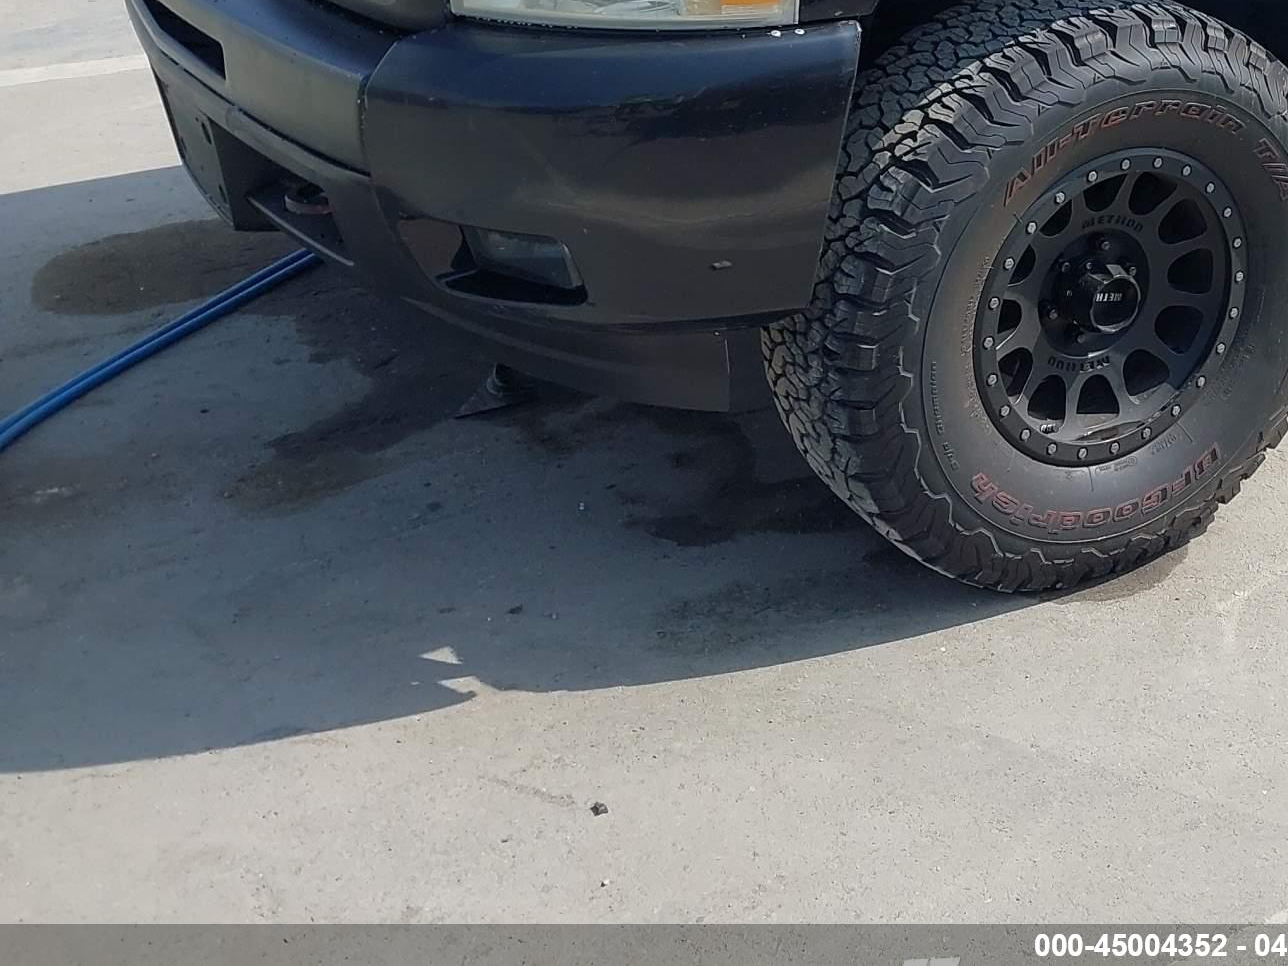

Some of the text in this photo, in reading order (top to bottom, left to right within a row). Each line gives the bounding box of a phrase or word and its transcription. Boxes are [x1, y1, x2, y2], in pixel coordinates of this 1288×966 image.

[1002, 97, 1249, 207] All-Terrain
[1081, 214, 1145, 233] METHOD
[970, 441, 1224, 535] BFGoodrich
